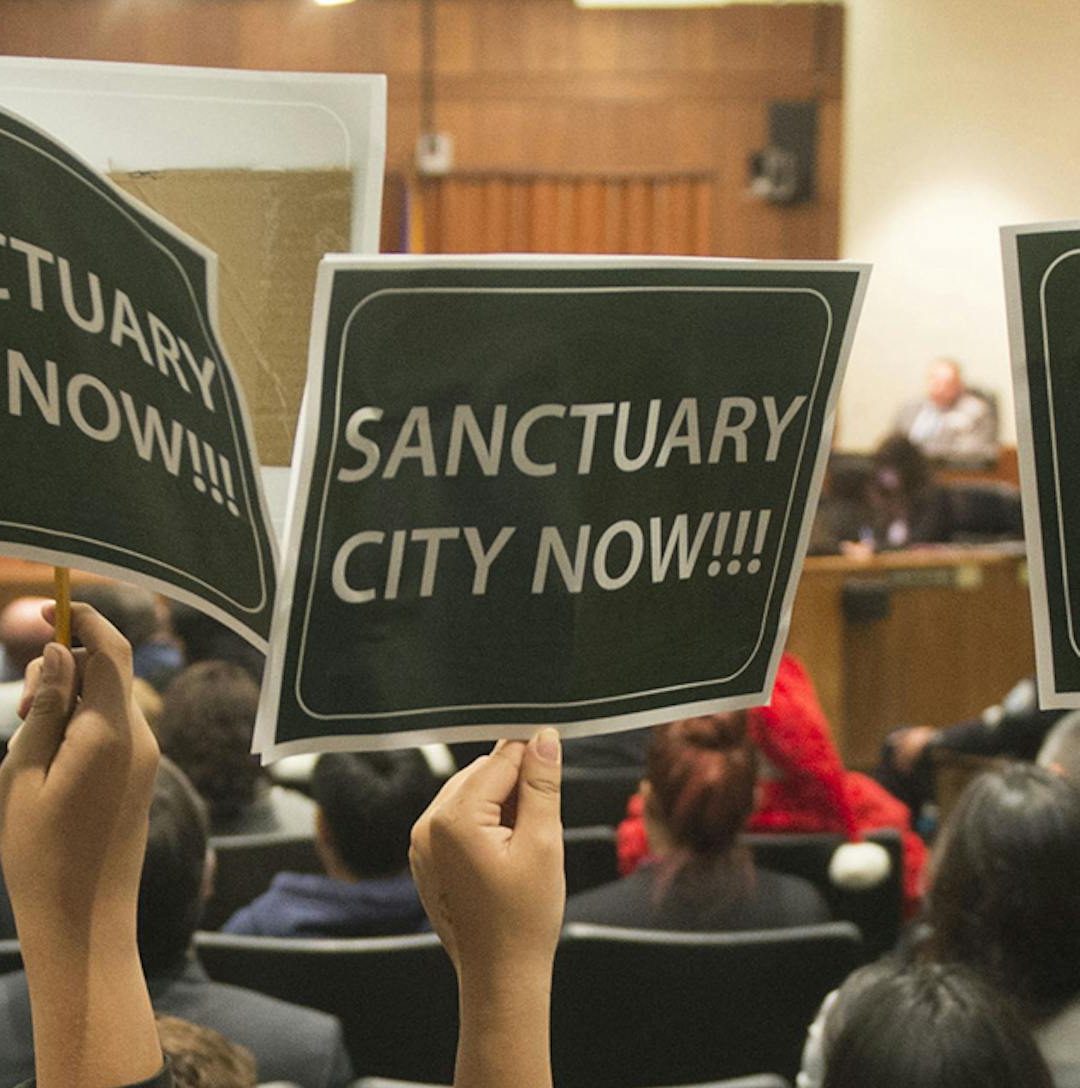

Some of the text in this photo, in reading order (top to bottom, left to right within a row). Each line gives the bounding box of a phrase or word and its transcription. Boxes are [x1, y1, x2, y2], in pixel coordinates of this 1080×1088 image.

[7, 350, 240, 517] NOW!!!
[337, 395, 808, 483] SANCTUARY
[331, 509, 772, 604] CITY NOW!!!
